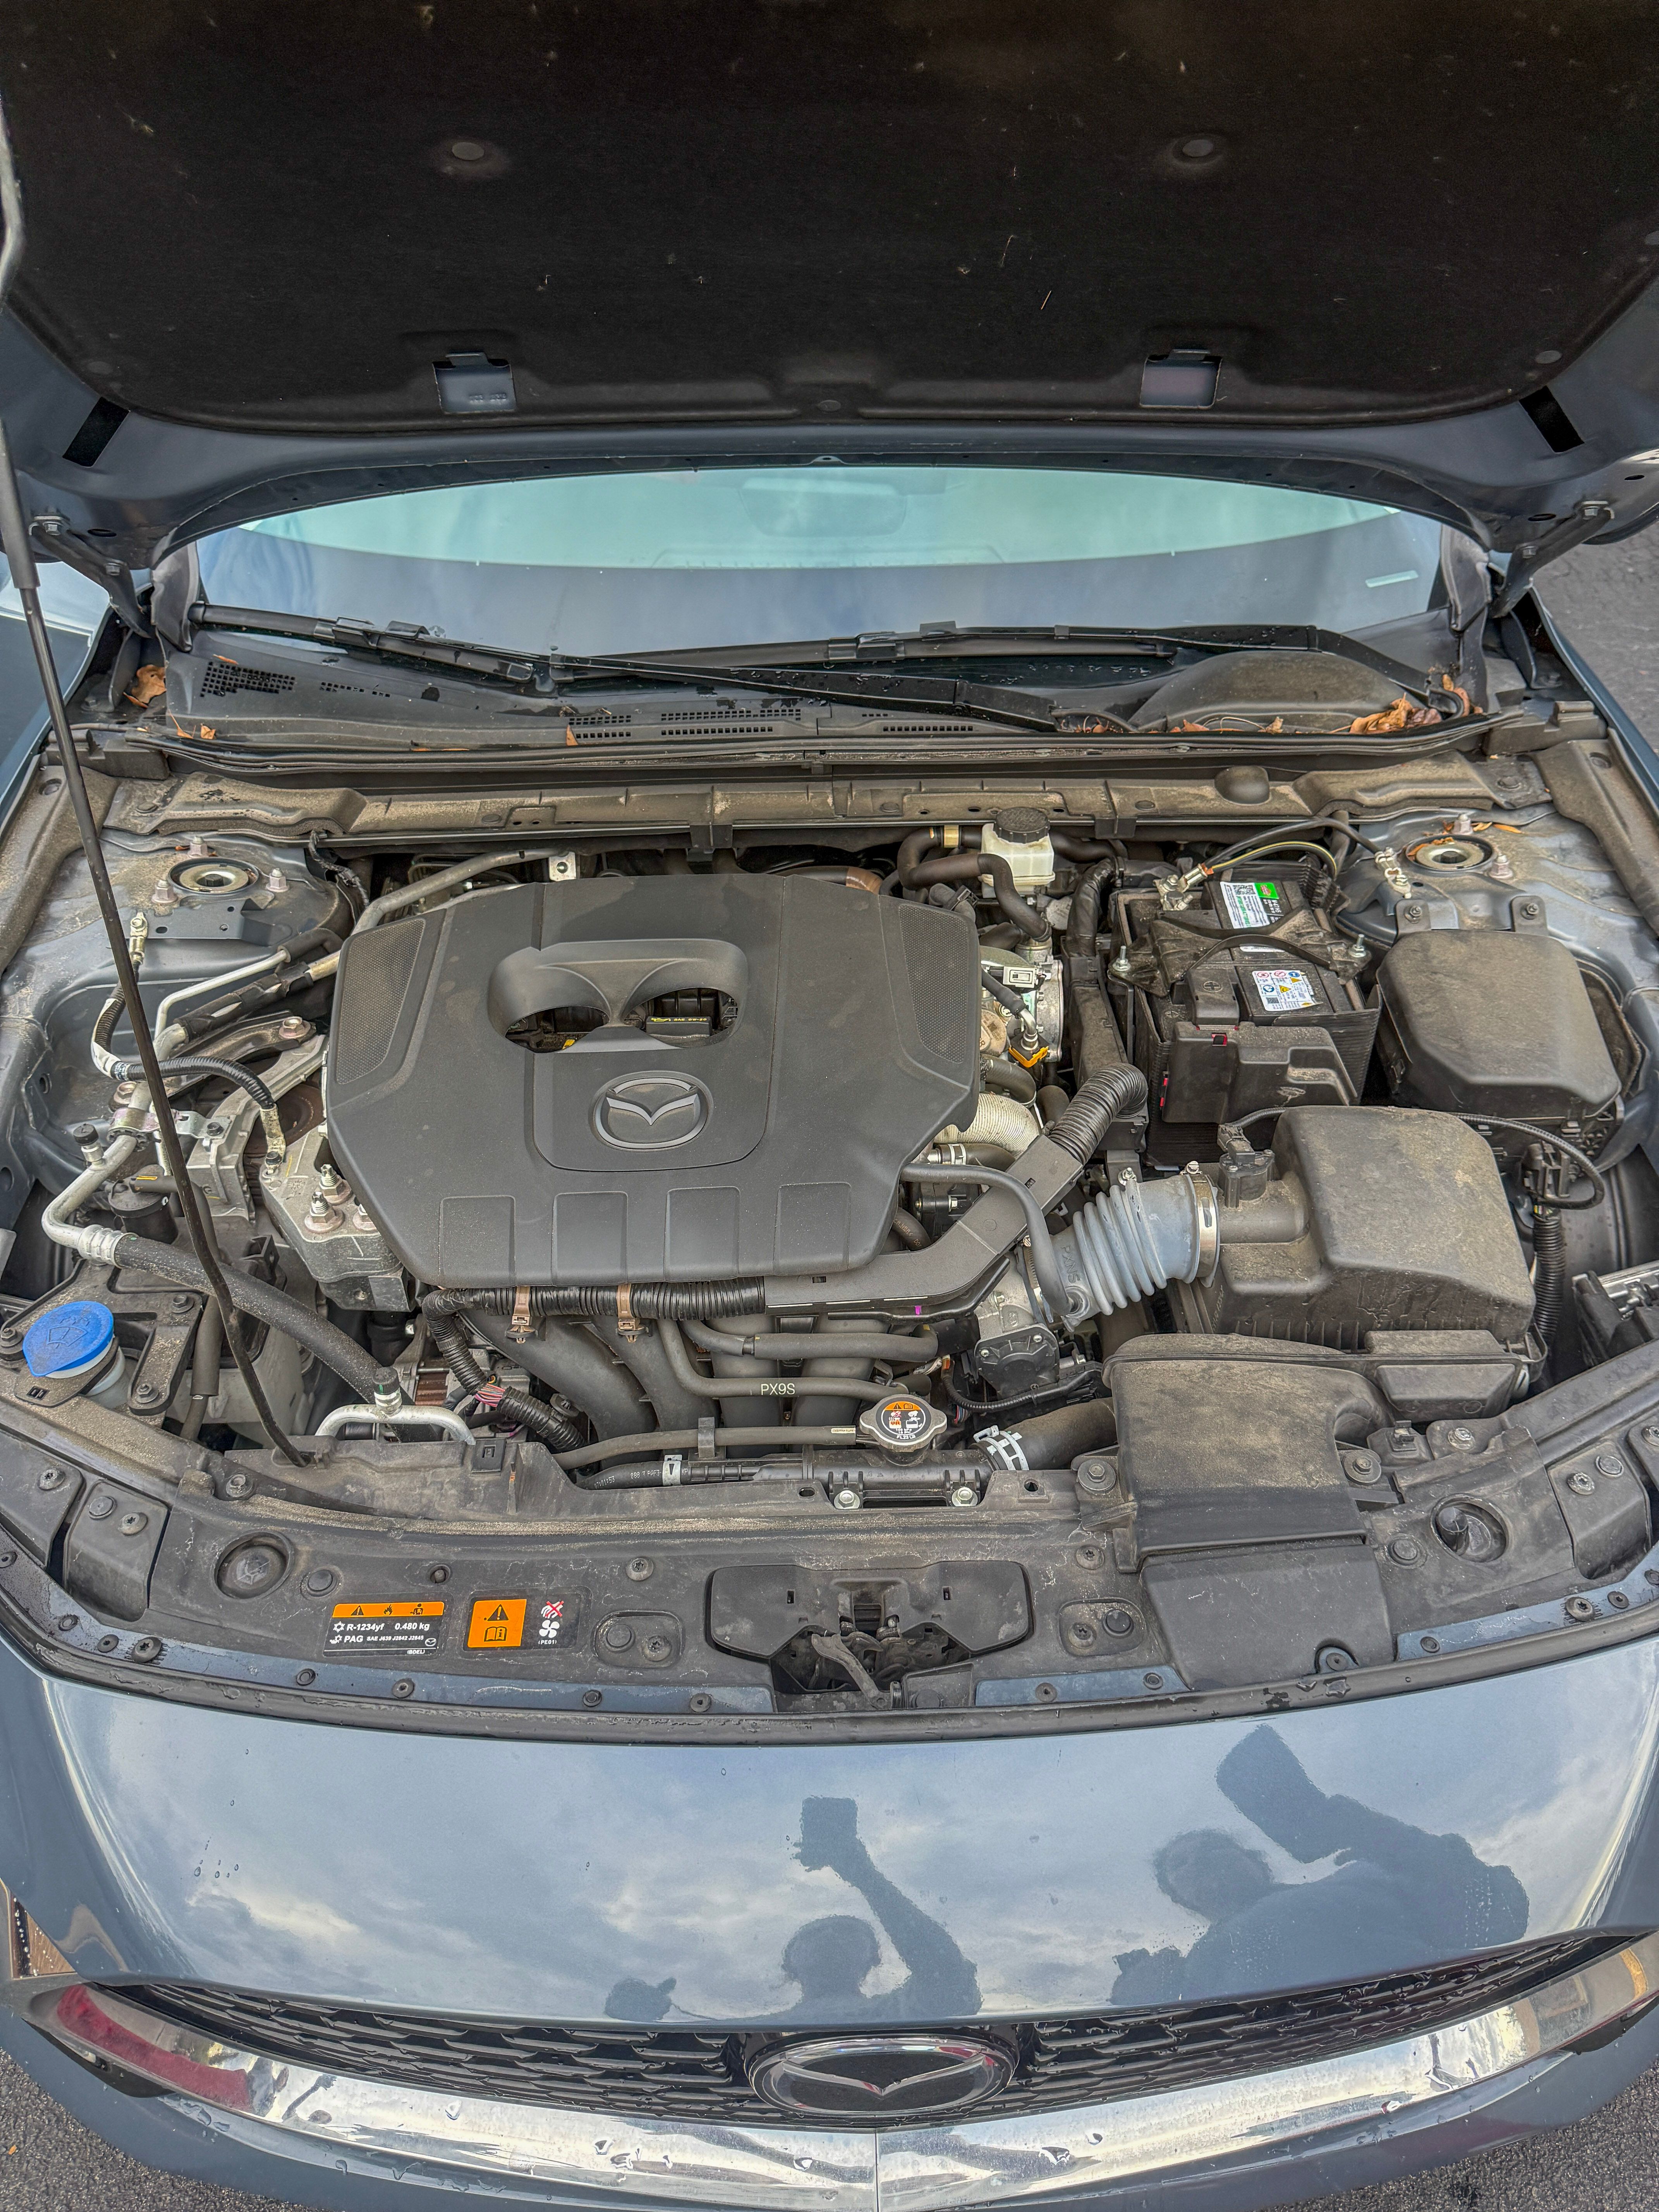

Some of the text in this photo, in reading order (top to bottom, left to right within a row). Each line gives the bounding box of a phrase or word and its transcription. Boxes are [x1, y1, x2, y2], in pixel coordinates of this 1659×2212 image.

[761, 1383, 795, 1395] PX9S
[346, 1623, 385, 1632] R-1234yf
[419, 1622, 430, 1631] kg
